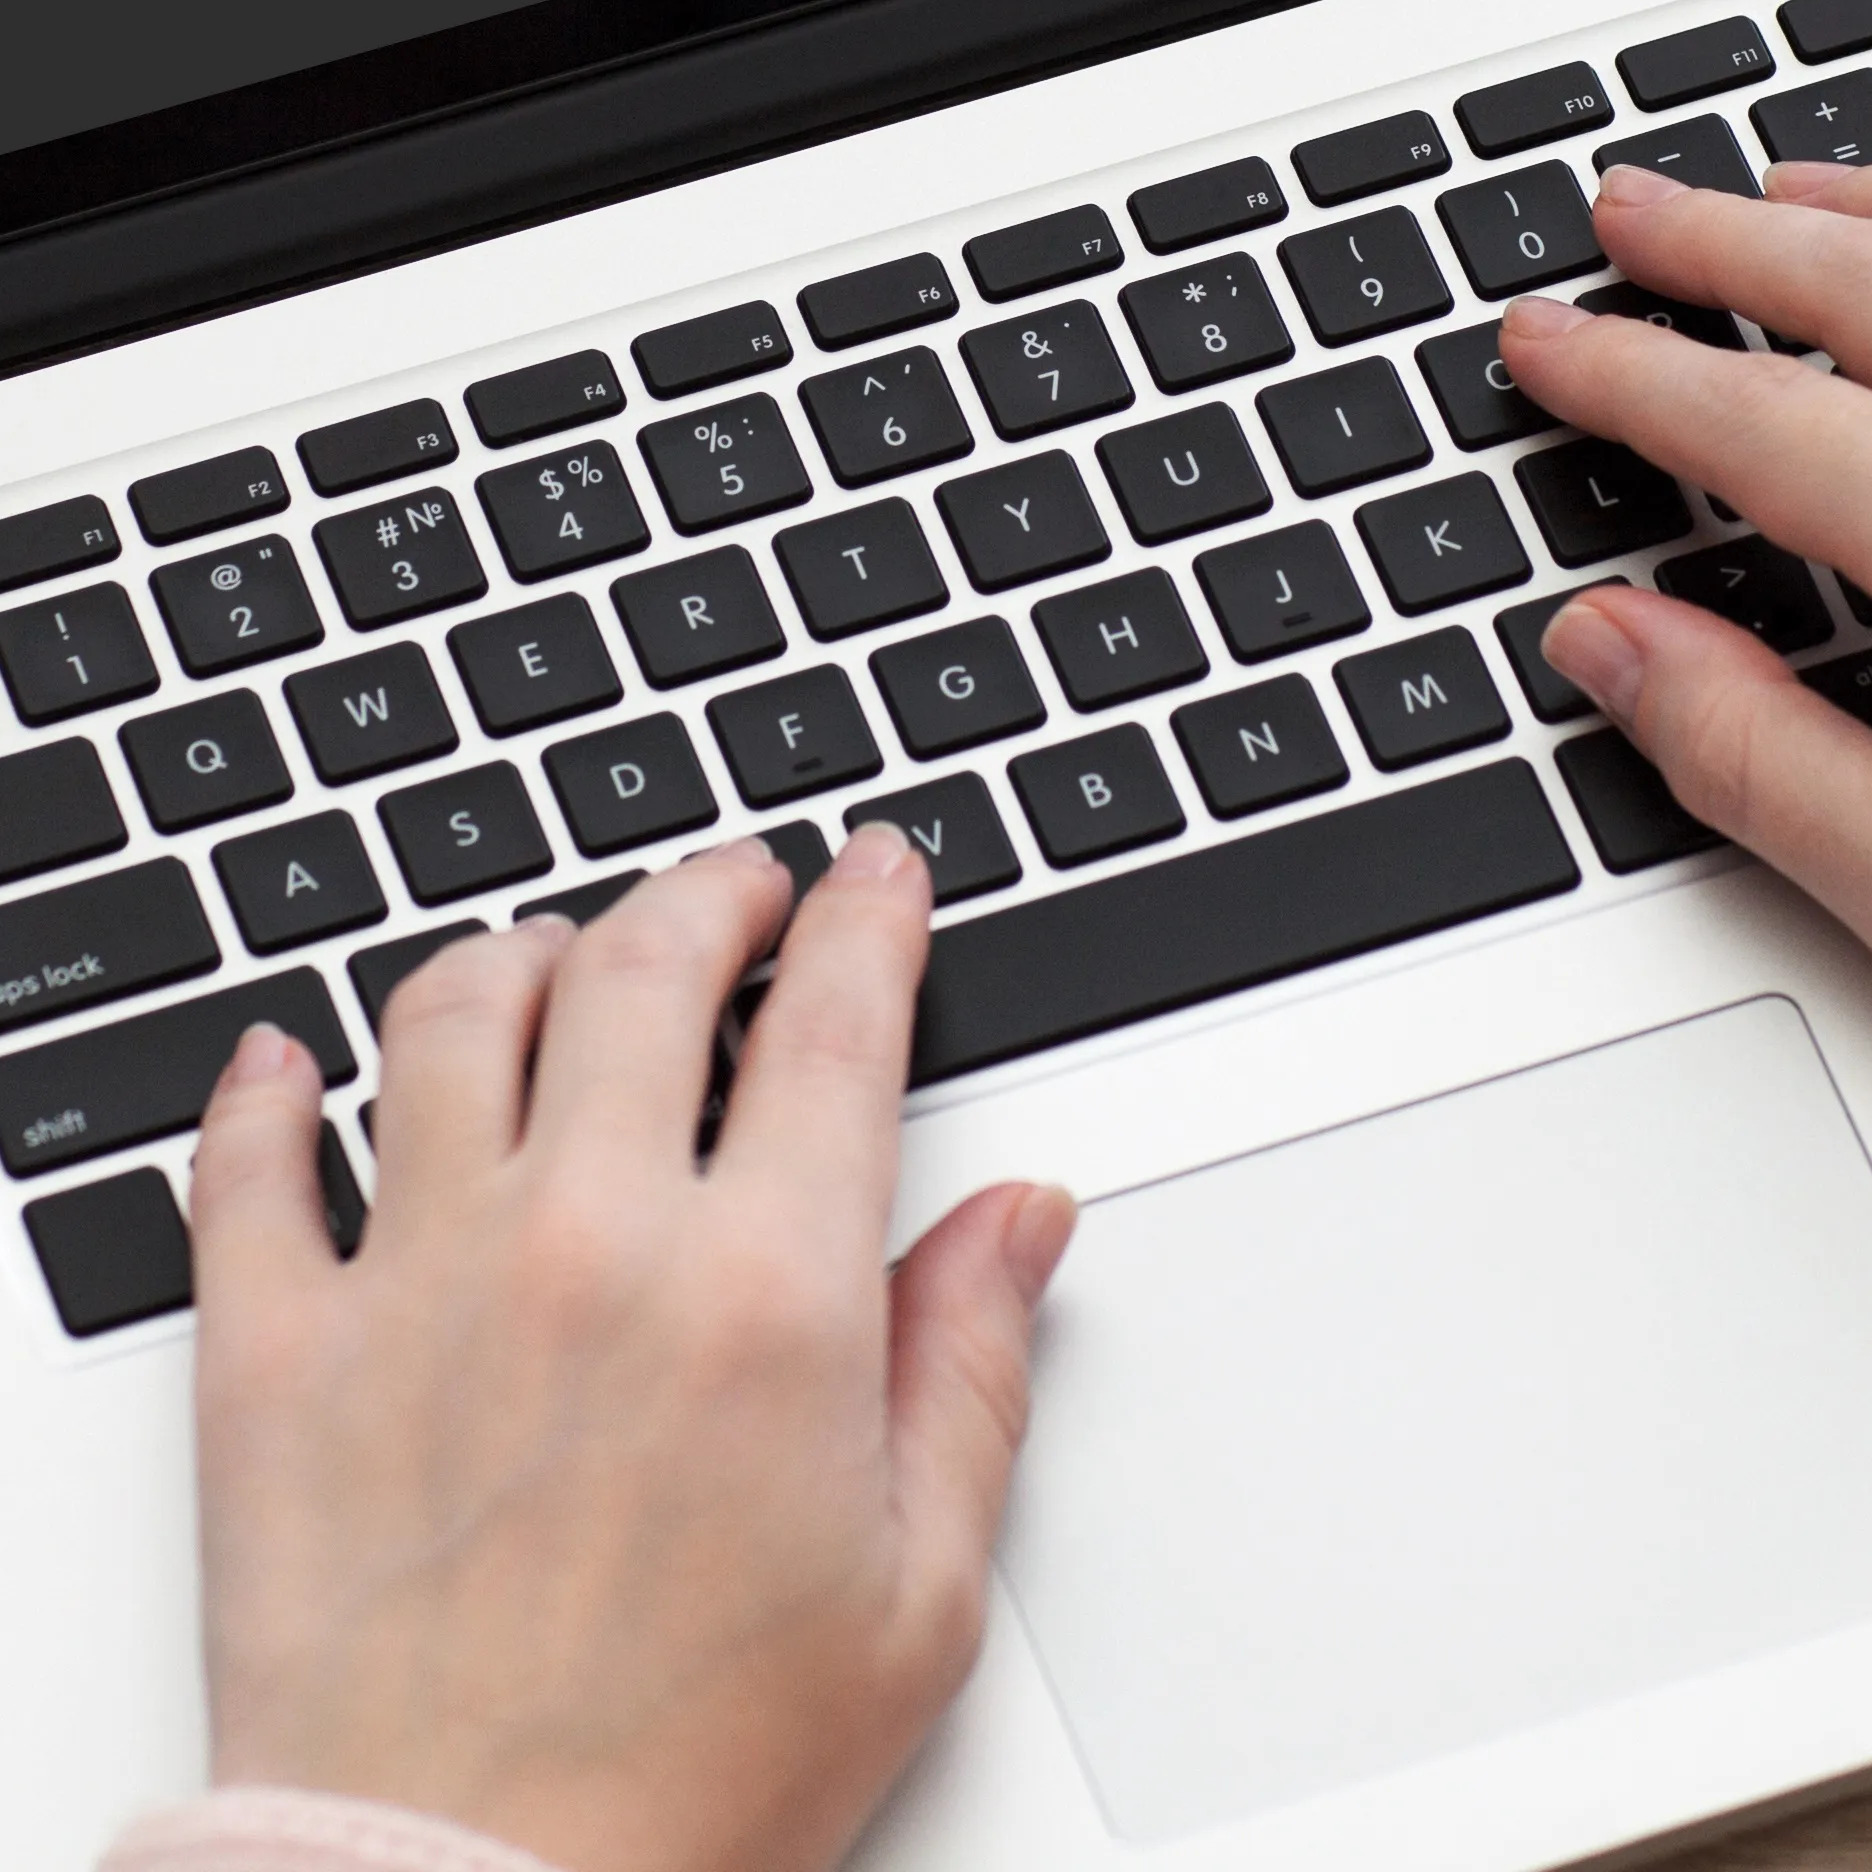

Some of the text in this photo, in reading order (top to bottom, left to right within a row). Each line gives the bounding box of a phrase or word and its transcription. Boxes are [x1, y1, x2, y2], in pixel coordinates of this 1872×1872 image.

[1731, 48, 1759, 66] F11
[1564, 95, 1595, 114] F10
[1815, 102, 1839, 122] +
[1410, 143, 1432, 160] F9
[1832, 143, 1860, 160] =
[1246, 191, 1269, 209] F8
[1503, 190, 1520, 217] )
[1081, 238, 1102, 256] F7
[1348, 235, 1364, 263] (
[1518, 231, 1545, 260] 0
[918, 286, 941, 304] F6
[1360, 277, 1384, 307] 9
[751, 334, 774, 352] F5
[1021, 330, 1053, 359] &
[1201, 323, 1228, 353] 8
[583, 383, 607, 401] F4
[1037, 369, 1060, 401] 7
[694, 421, 733, 454] %
[882, 416, 907, 447] 6
[1335, 407, 1353, 438] I
[416, 433, 440, 450] F3
[538, 455, 604, 501] $ %
[719, 463, 745, 496] 5
[1163, 450, 1200, 486] U
[247, 480, 272, 498] F2
[1588, 477, 1620, 507] L
[558, 511, 584, 540] 4
[1003, 497, 1031, 532] Y
[83, 528, 104, 546] F1
[375, 516, 401, 548] #
[1424, 520, 1463, 557] K
[210, 564, 242, 591] @
[391, 560, 419, 591] 3
[841, 546, 868, 580] T
[1275, 569, 1293, 604] J
[54, 612, 70, 641] !
[229, 606, 260, 638] 2
[680, 595, 715, 630] R
[1098, 616, 1139, 655] H
[66, 655, 89, 685] 1
[518, 642, 549, 678] E
[938, 665, 975, 700] G
[1401, 673, 1448, 714] M
[343, 687, 389, 728] W
[778, 713, 803, 749] F
[1239, 722, 1280, 762] N
[186, 739, 228, 774] Q
[609, 762, 646, 799] D
[1079, 773, 1112, 809] B
[449, 811, 480, 847] S
[910, 818, 943, 857] V
[286, 861, 319, 898] A
[42, 952, 104, 989] lock
[23, 1108, 87, 1147] shift
